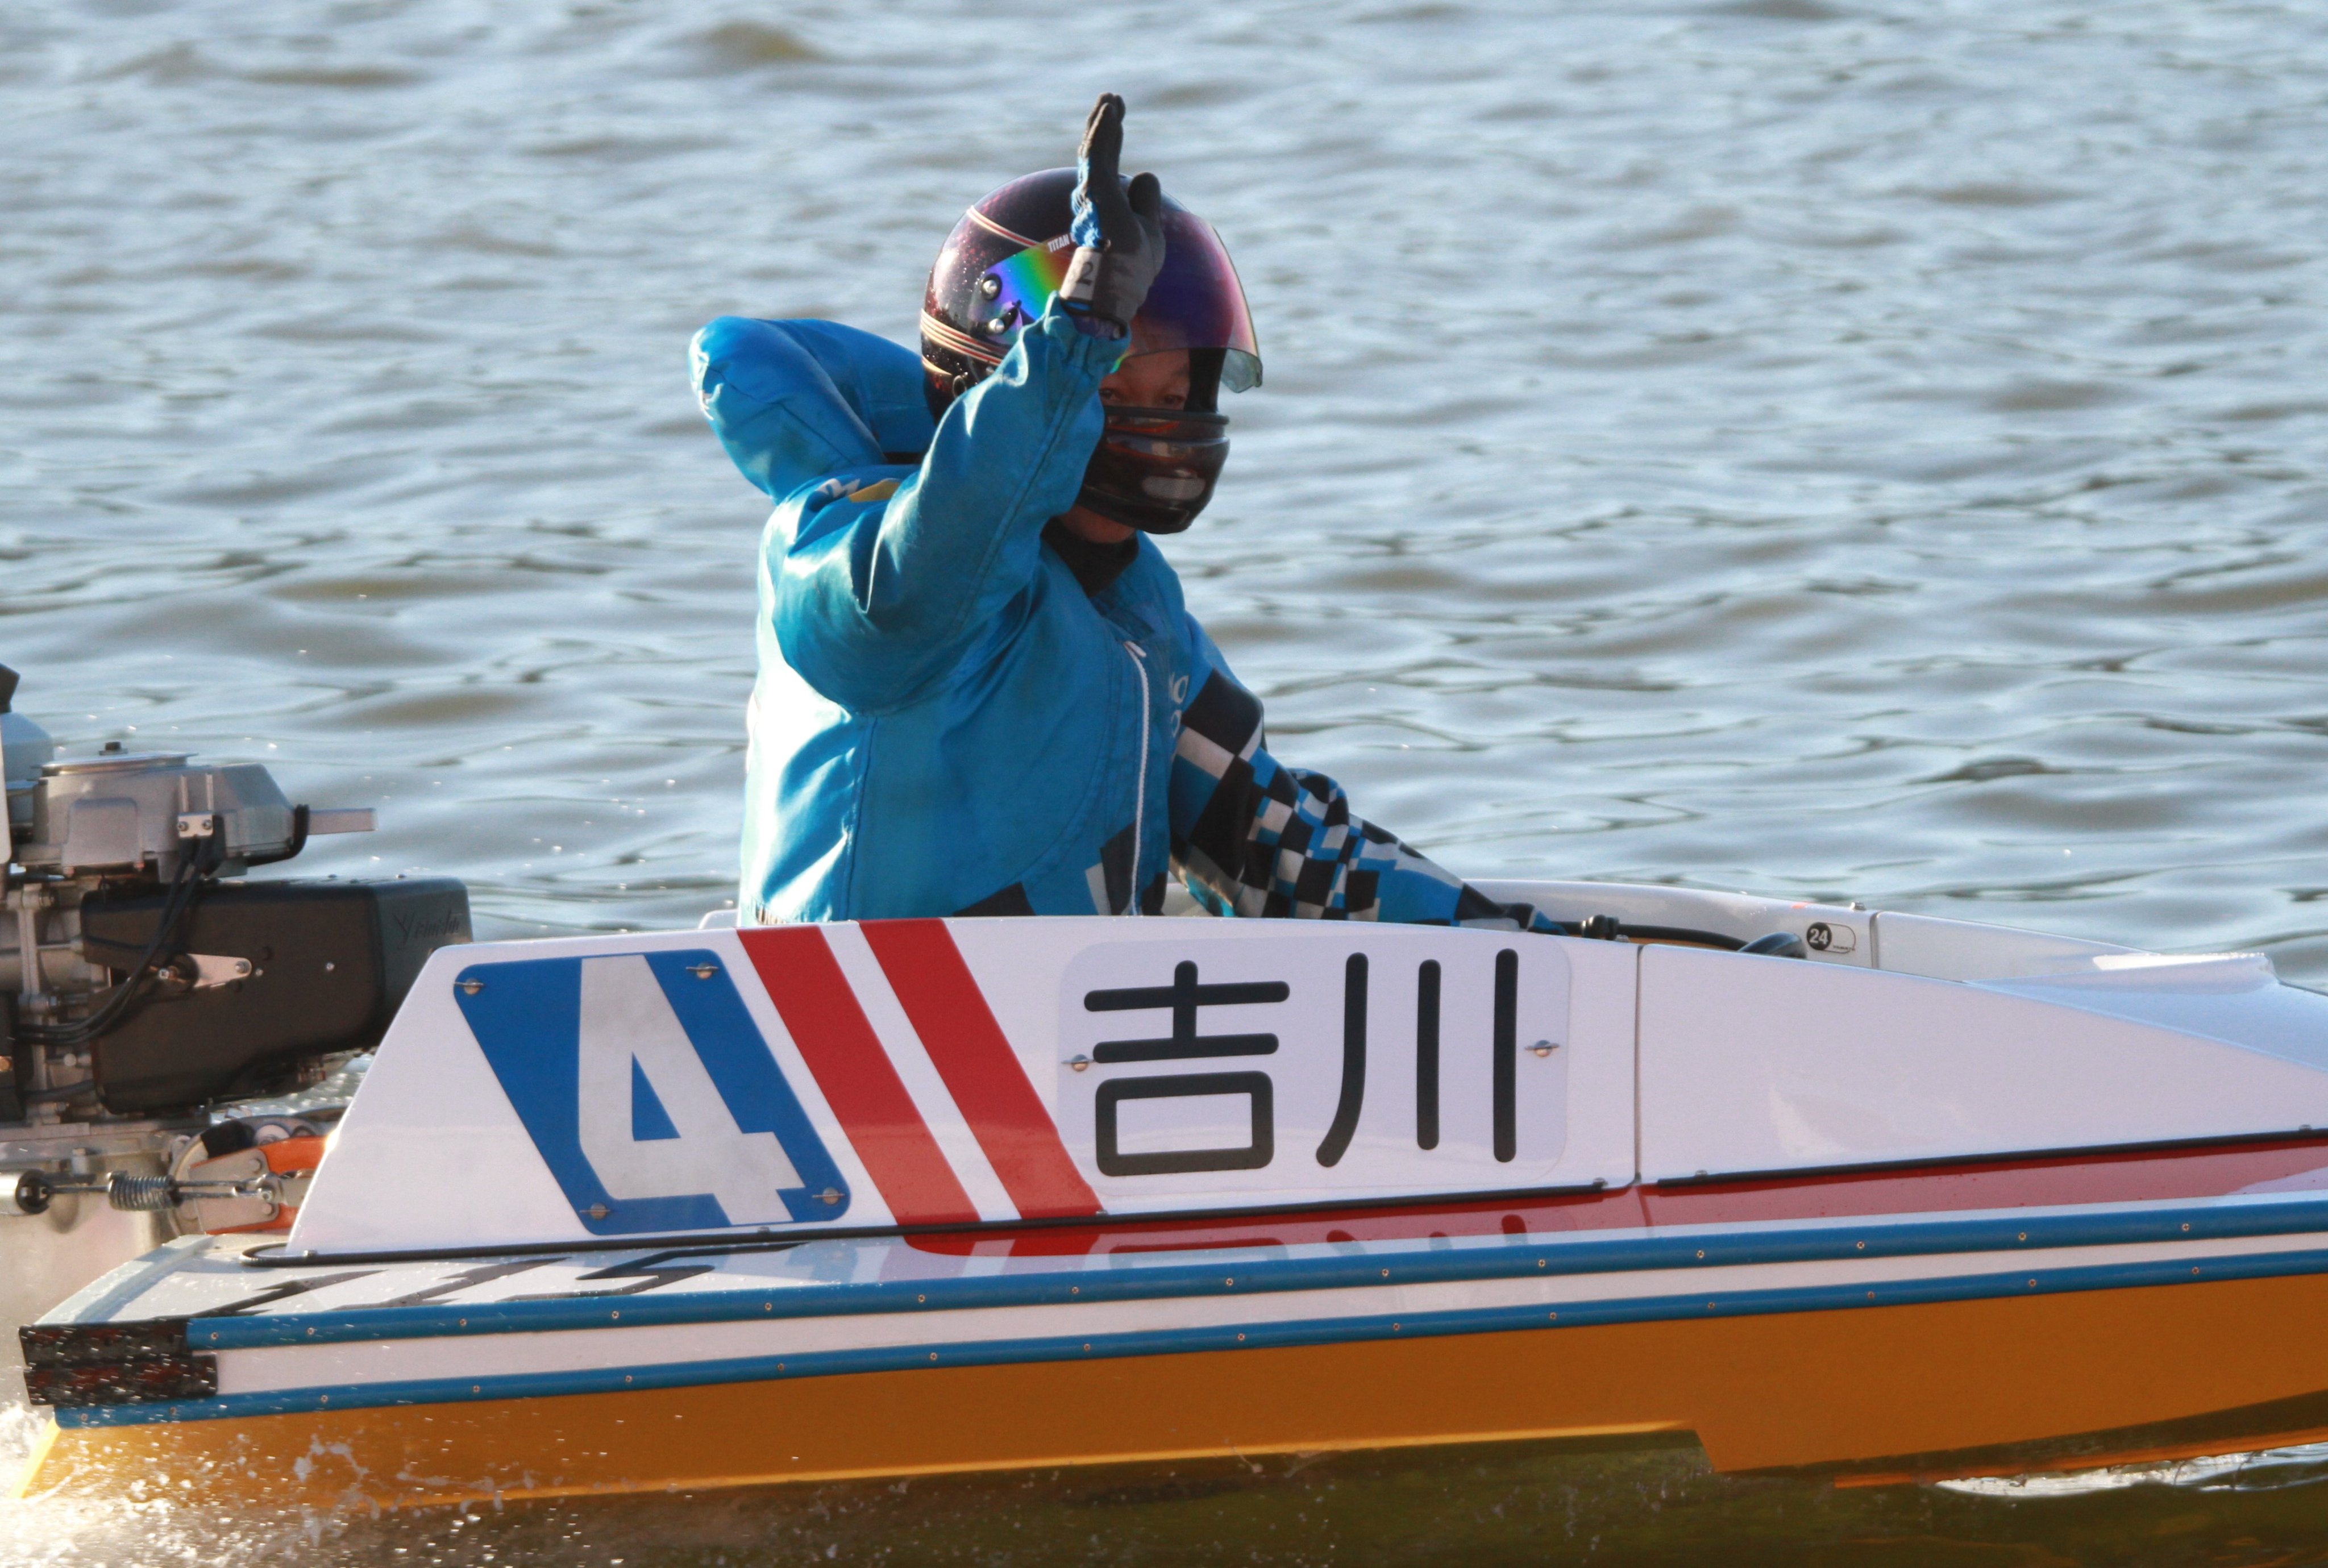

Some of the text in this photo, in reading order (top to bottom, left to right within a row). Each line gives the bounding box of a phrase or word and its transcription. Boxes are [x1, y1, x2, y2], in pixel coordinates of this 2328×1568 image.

[1047, 234, 1070, 252] TITAN
[1809, 928, 1829, 945] 24
[579, 954, 804, 1225] 4
[1084, 948, 1519, 1177] 吉川
